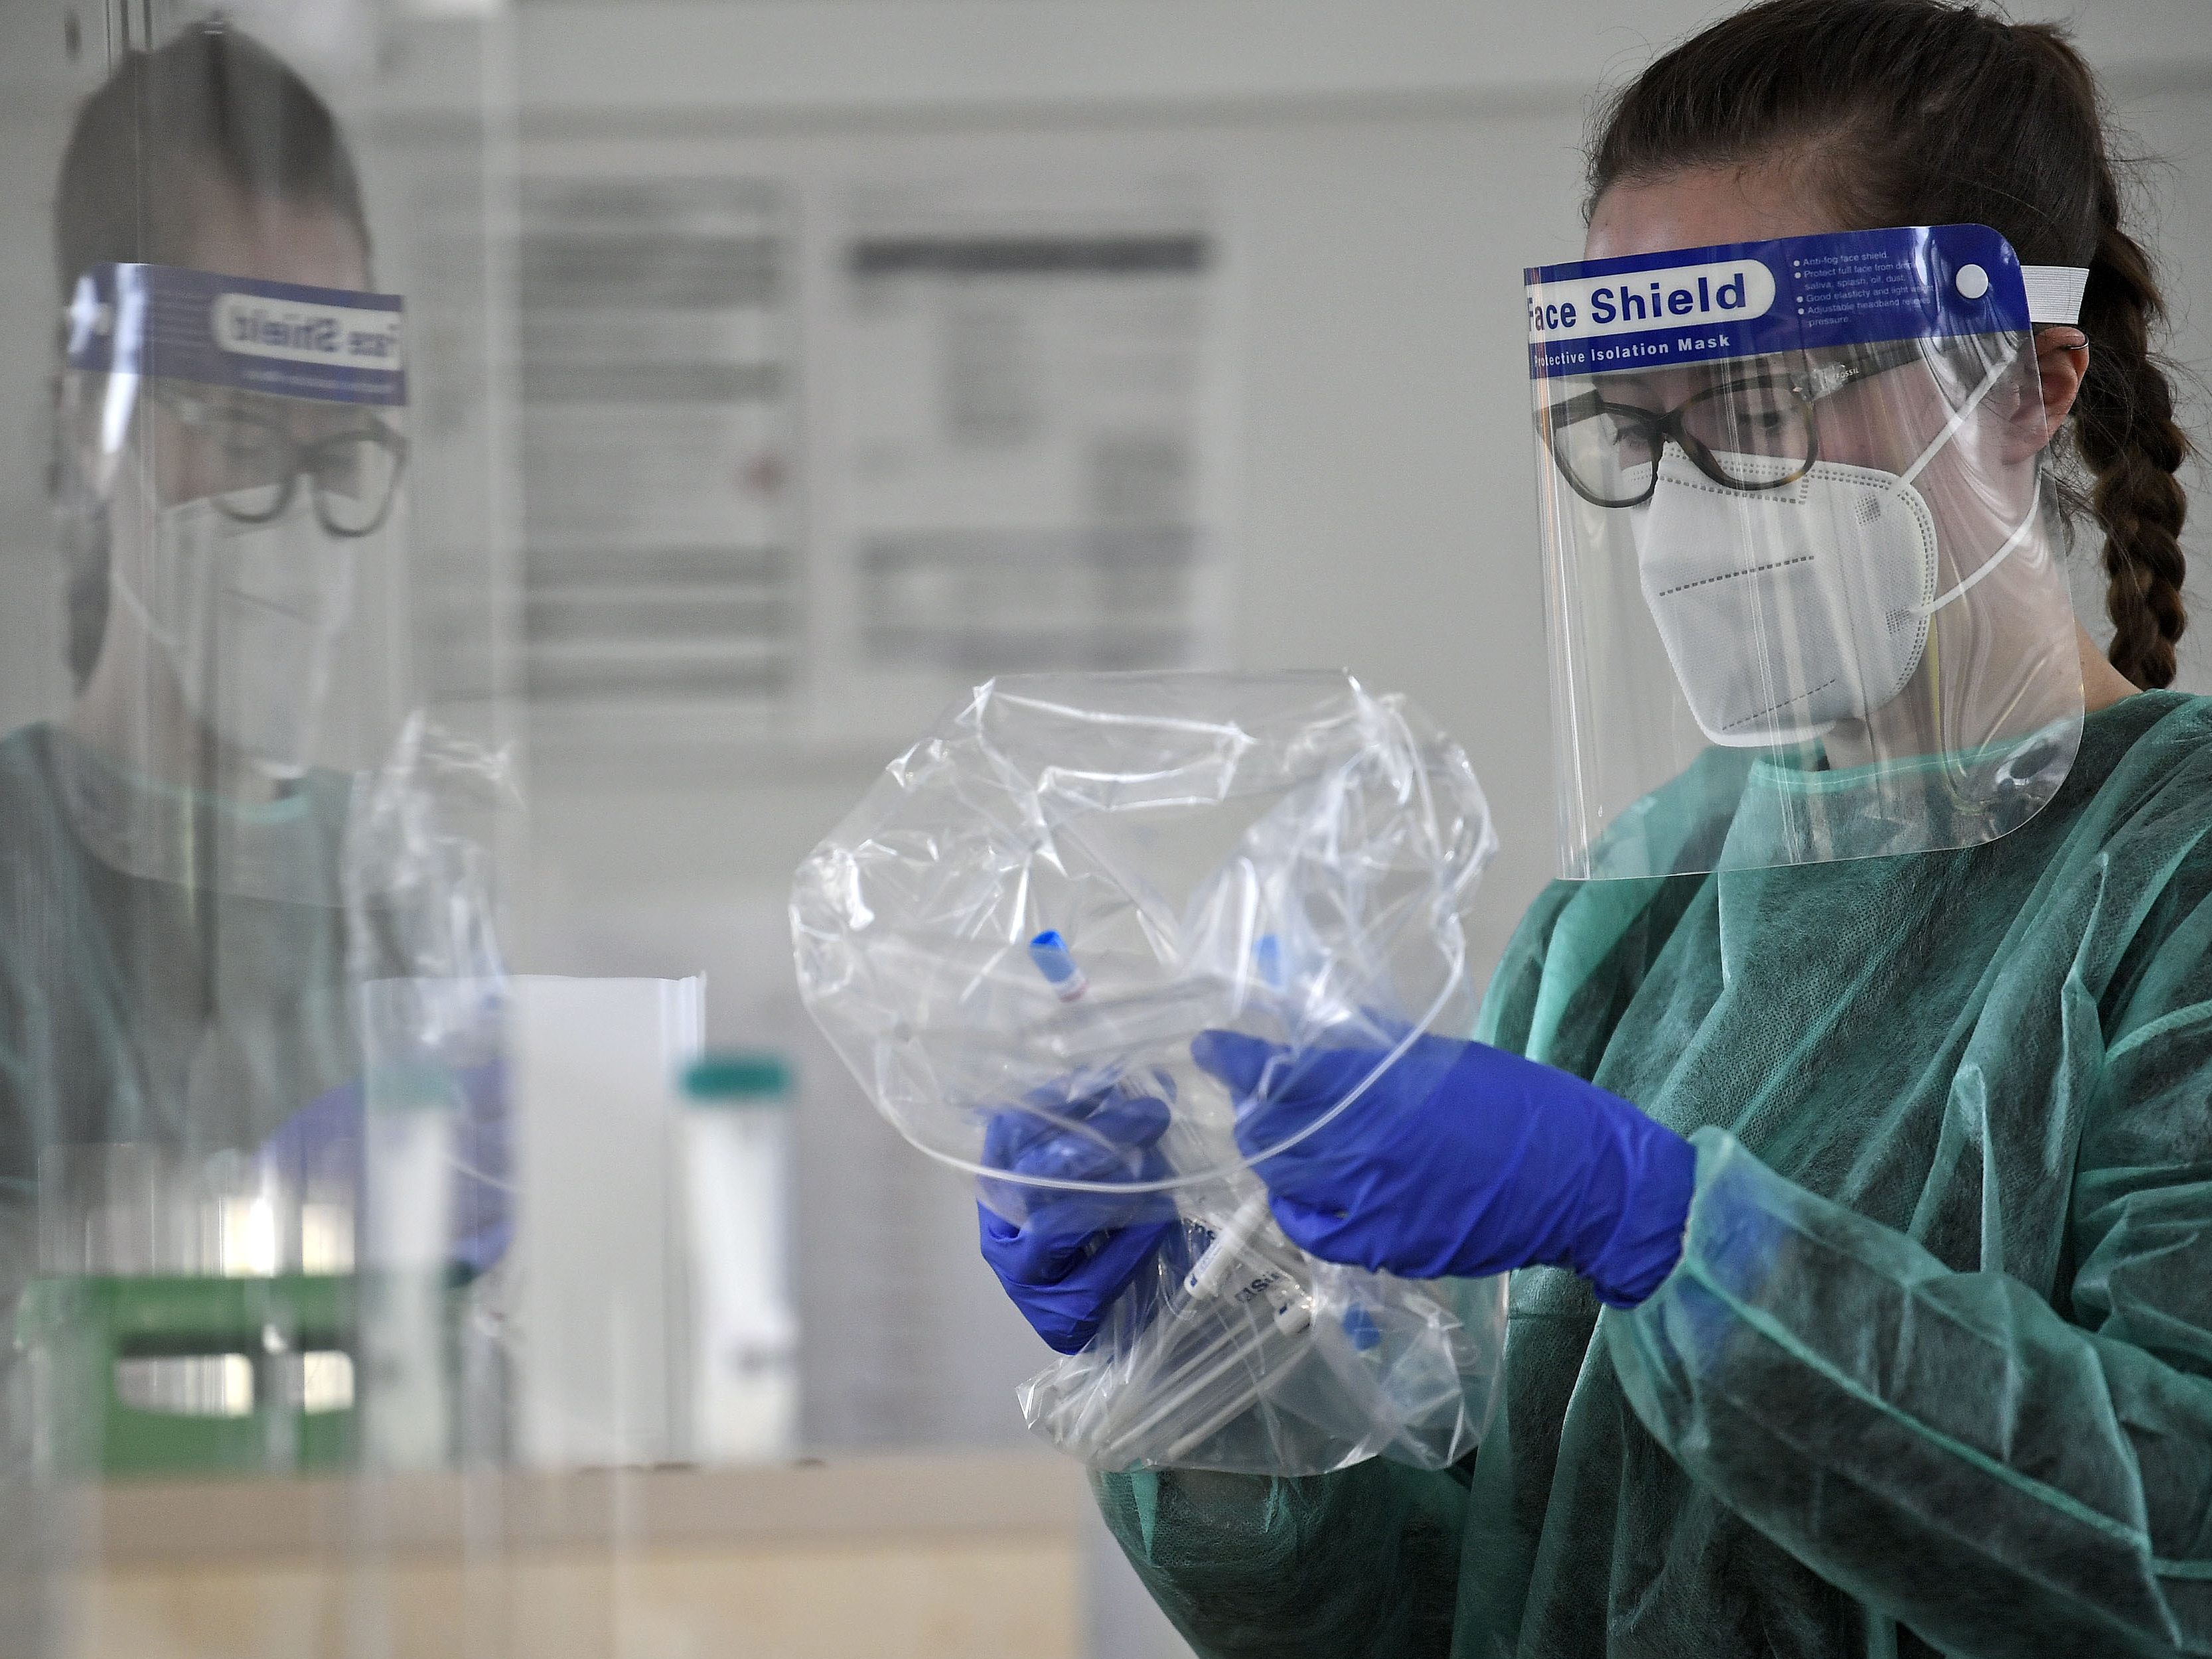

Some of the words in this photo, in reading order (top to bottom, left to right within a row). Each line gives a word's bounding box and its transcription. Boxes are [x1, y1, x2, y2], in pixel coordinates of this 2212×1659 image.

[1804, 268, 1836, 277] Protect
[1838, 266, 1852, 275] full
[1854, 264, 1873, 273] face
[1875, 263, 1893, 271] from
[1591, 273, 1747, 325] Shield
[1806, 293, 1831, 303] Good
[1807, 303, 1855, 315] Adjustable
[1591, 342, 1669, 362] Isolation
[1678, 334, 1731, 352] Mask
